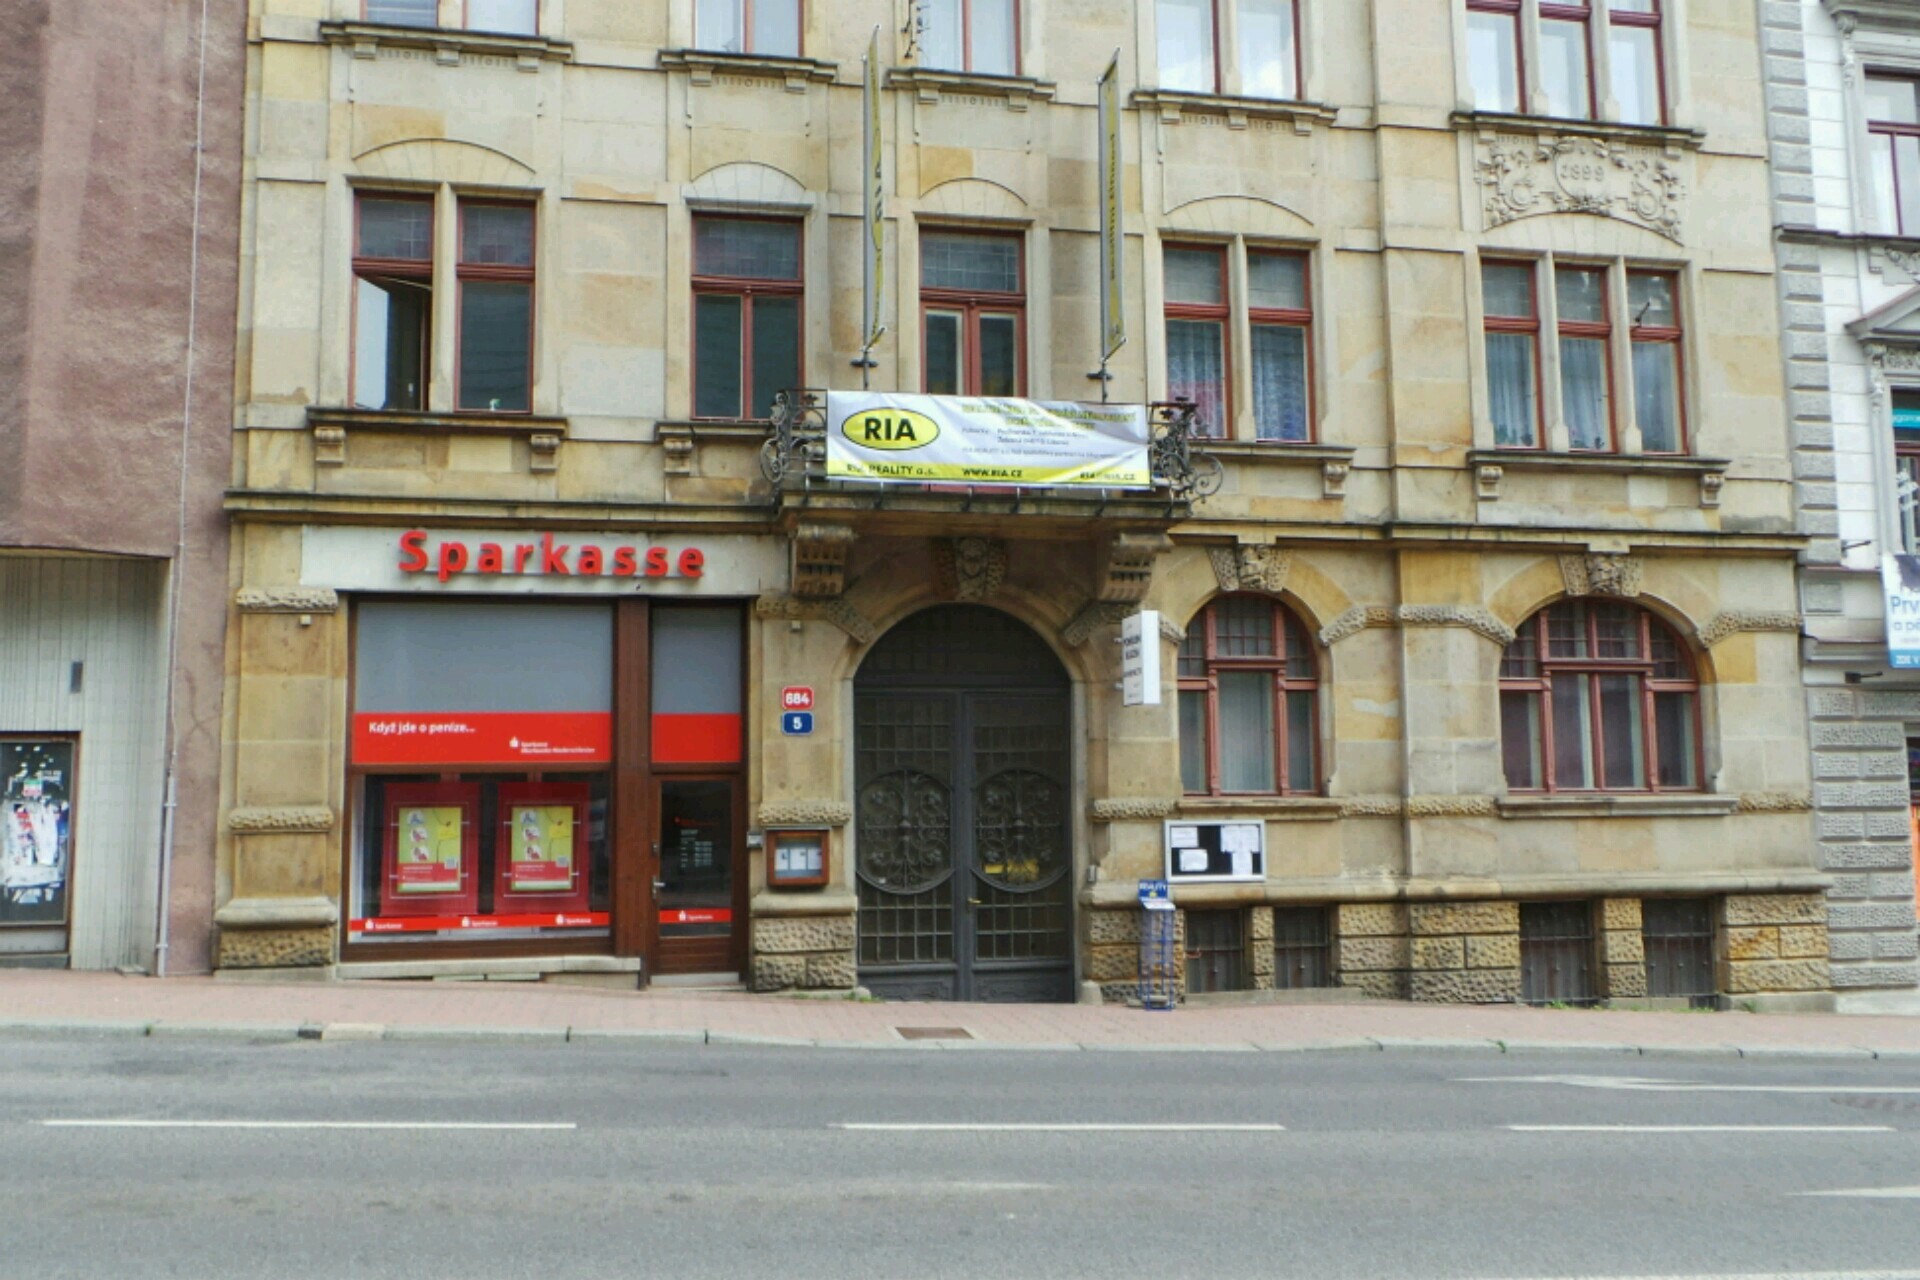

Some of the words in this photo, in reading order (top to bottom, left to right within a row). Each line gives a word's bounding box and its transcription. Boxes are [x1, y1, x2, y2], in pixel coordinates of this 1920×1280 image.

[864, 417, 917, 441] RIA
[398, 529, 704, 583] Sparkasse
[369, 721, 396, 735] Když
[398, 721, 417, 735] jde
[419, 724, 427, 733] o
[793, 716, 803, 730] 5
